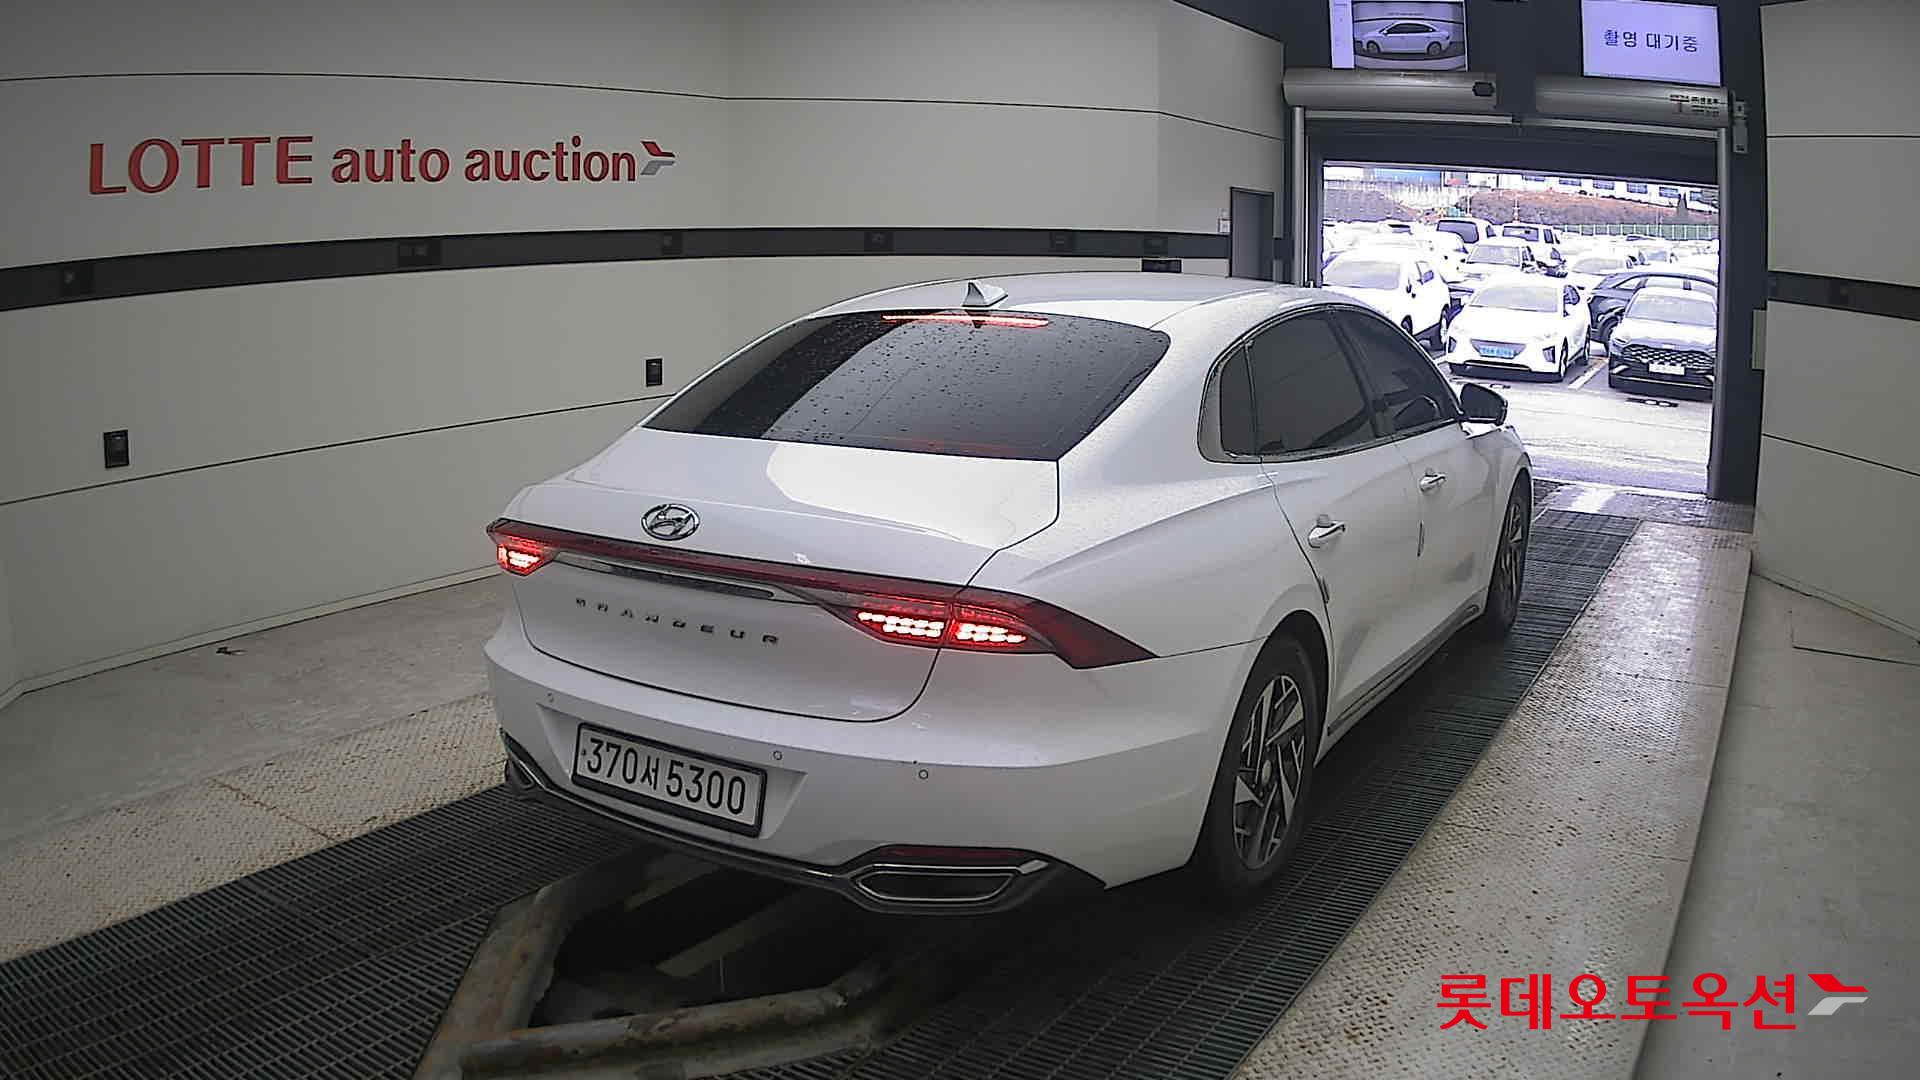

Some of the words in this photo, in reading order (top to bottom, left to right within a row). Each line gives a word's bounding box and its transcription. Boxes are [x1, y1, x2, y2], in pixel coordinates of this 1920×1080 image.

[1646, 32, 1697, 53] 대기중
[89, 136, 313, 195] LOTTE
[330, 138, 450, 184] auto
[464, 135, 637, 183] auction
